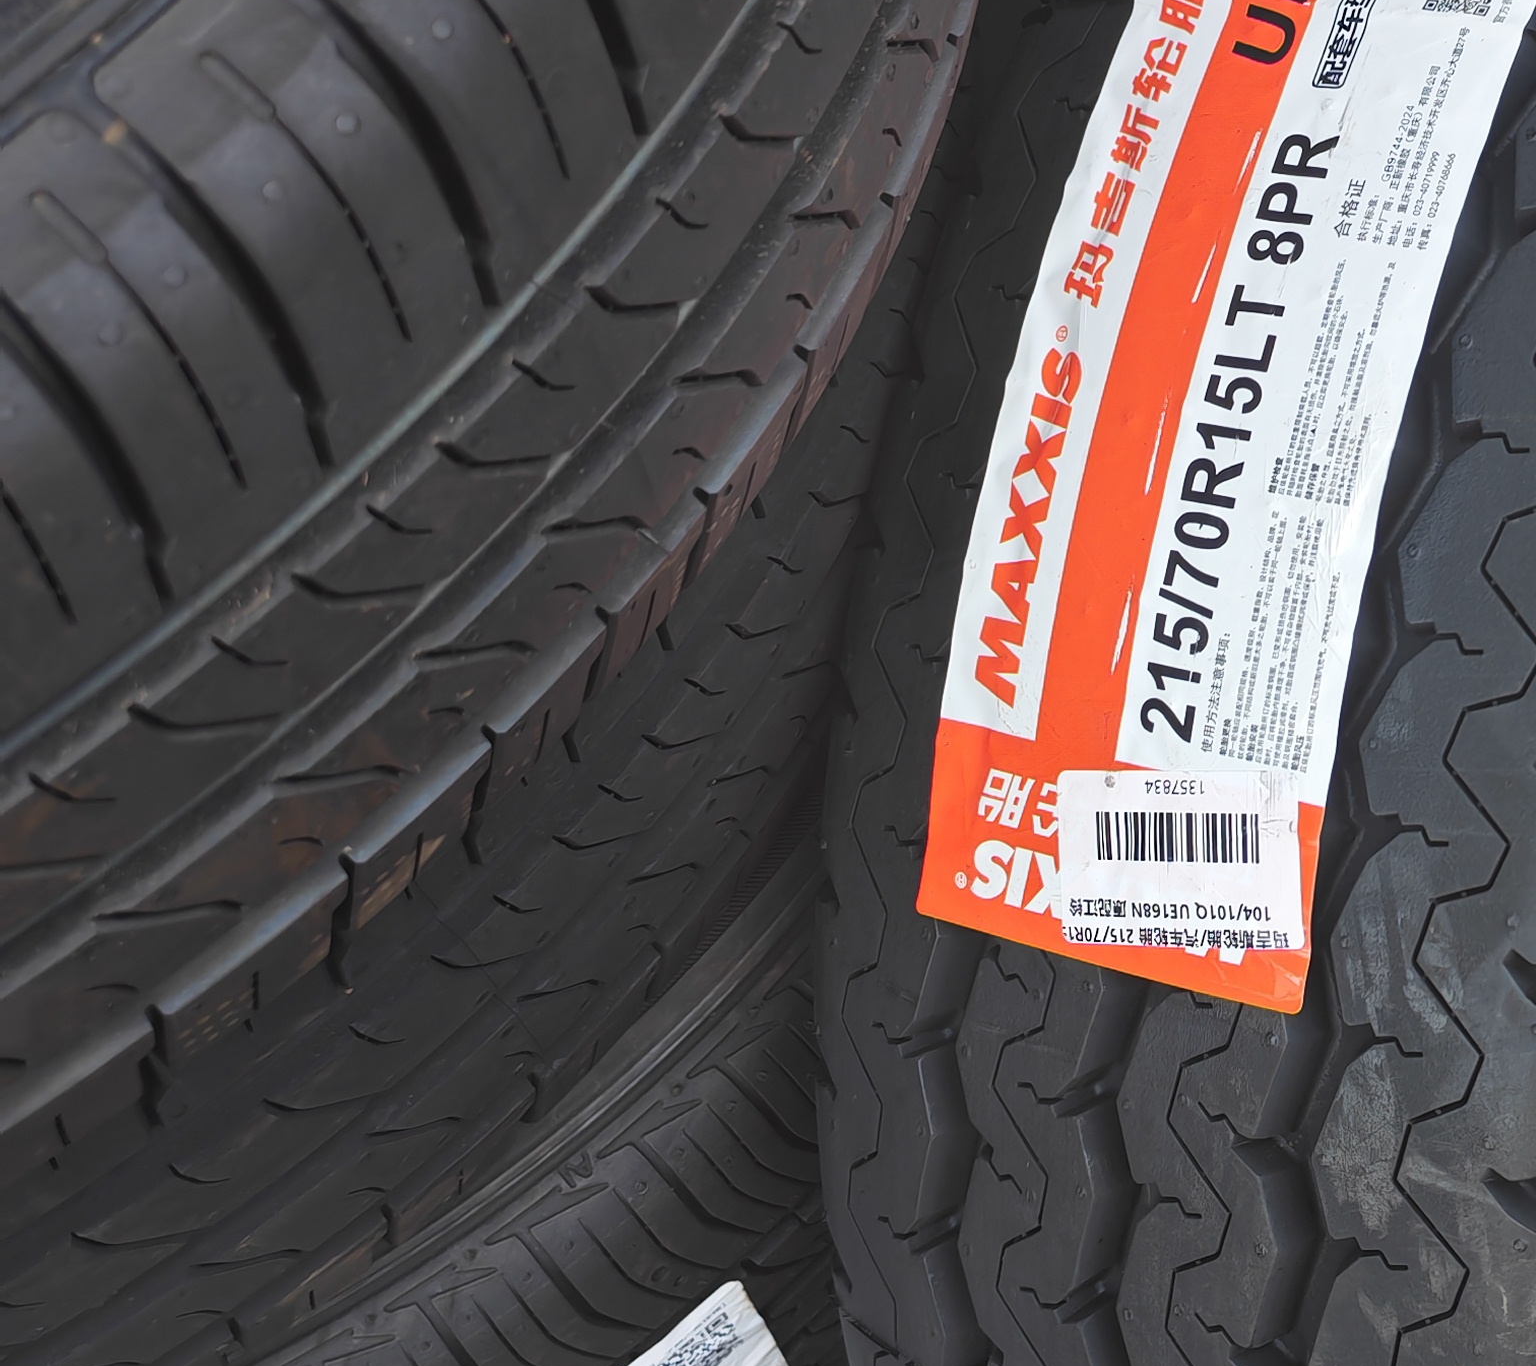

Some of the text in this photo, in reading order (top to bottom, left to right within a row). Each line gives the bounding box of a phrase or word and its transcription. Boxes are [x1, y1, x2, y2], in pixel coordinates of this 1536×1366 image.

[1379, 104, 1415, 182] GB9744-2024
[1330, 177, 1366, 239] 合格证
[1140, 132, 1341, 743] 215/70R15LT 8PR
[975, 348, 1082, 709] MAXXIS
[1218, 717, 1232, 756] 轮胎更换
[1243, 723, 1259, 762] 轮胎安装
[1144, 777, 1205, 797] 1357834
[1069, 897, 1271, 922] 104/101Q UE168N 原配江铃
